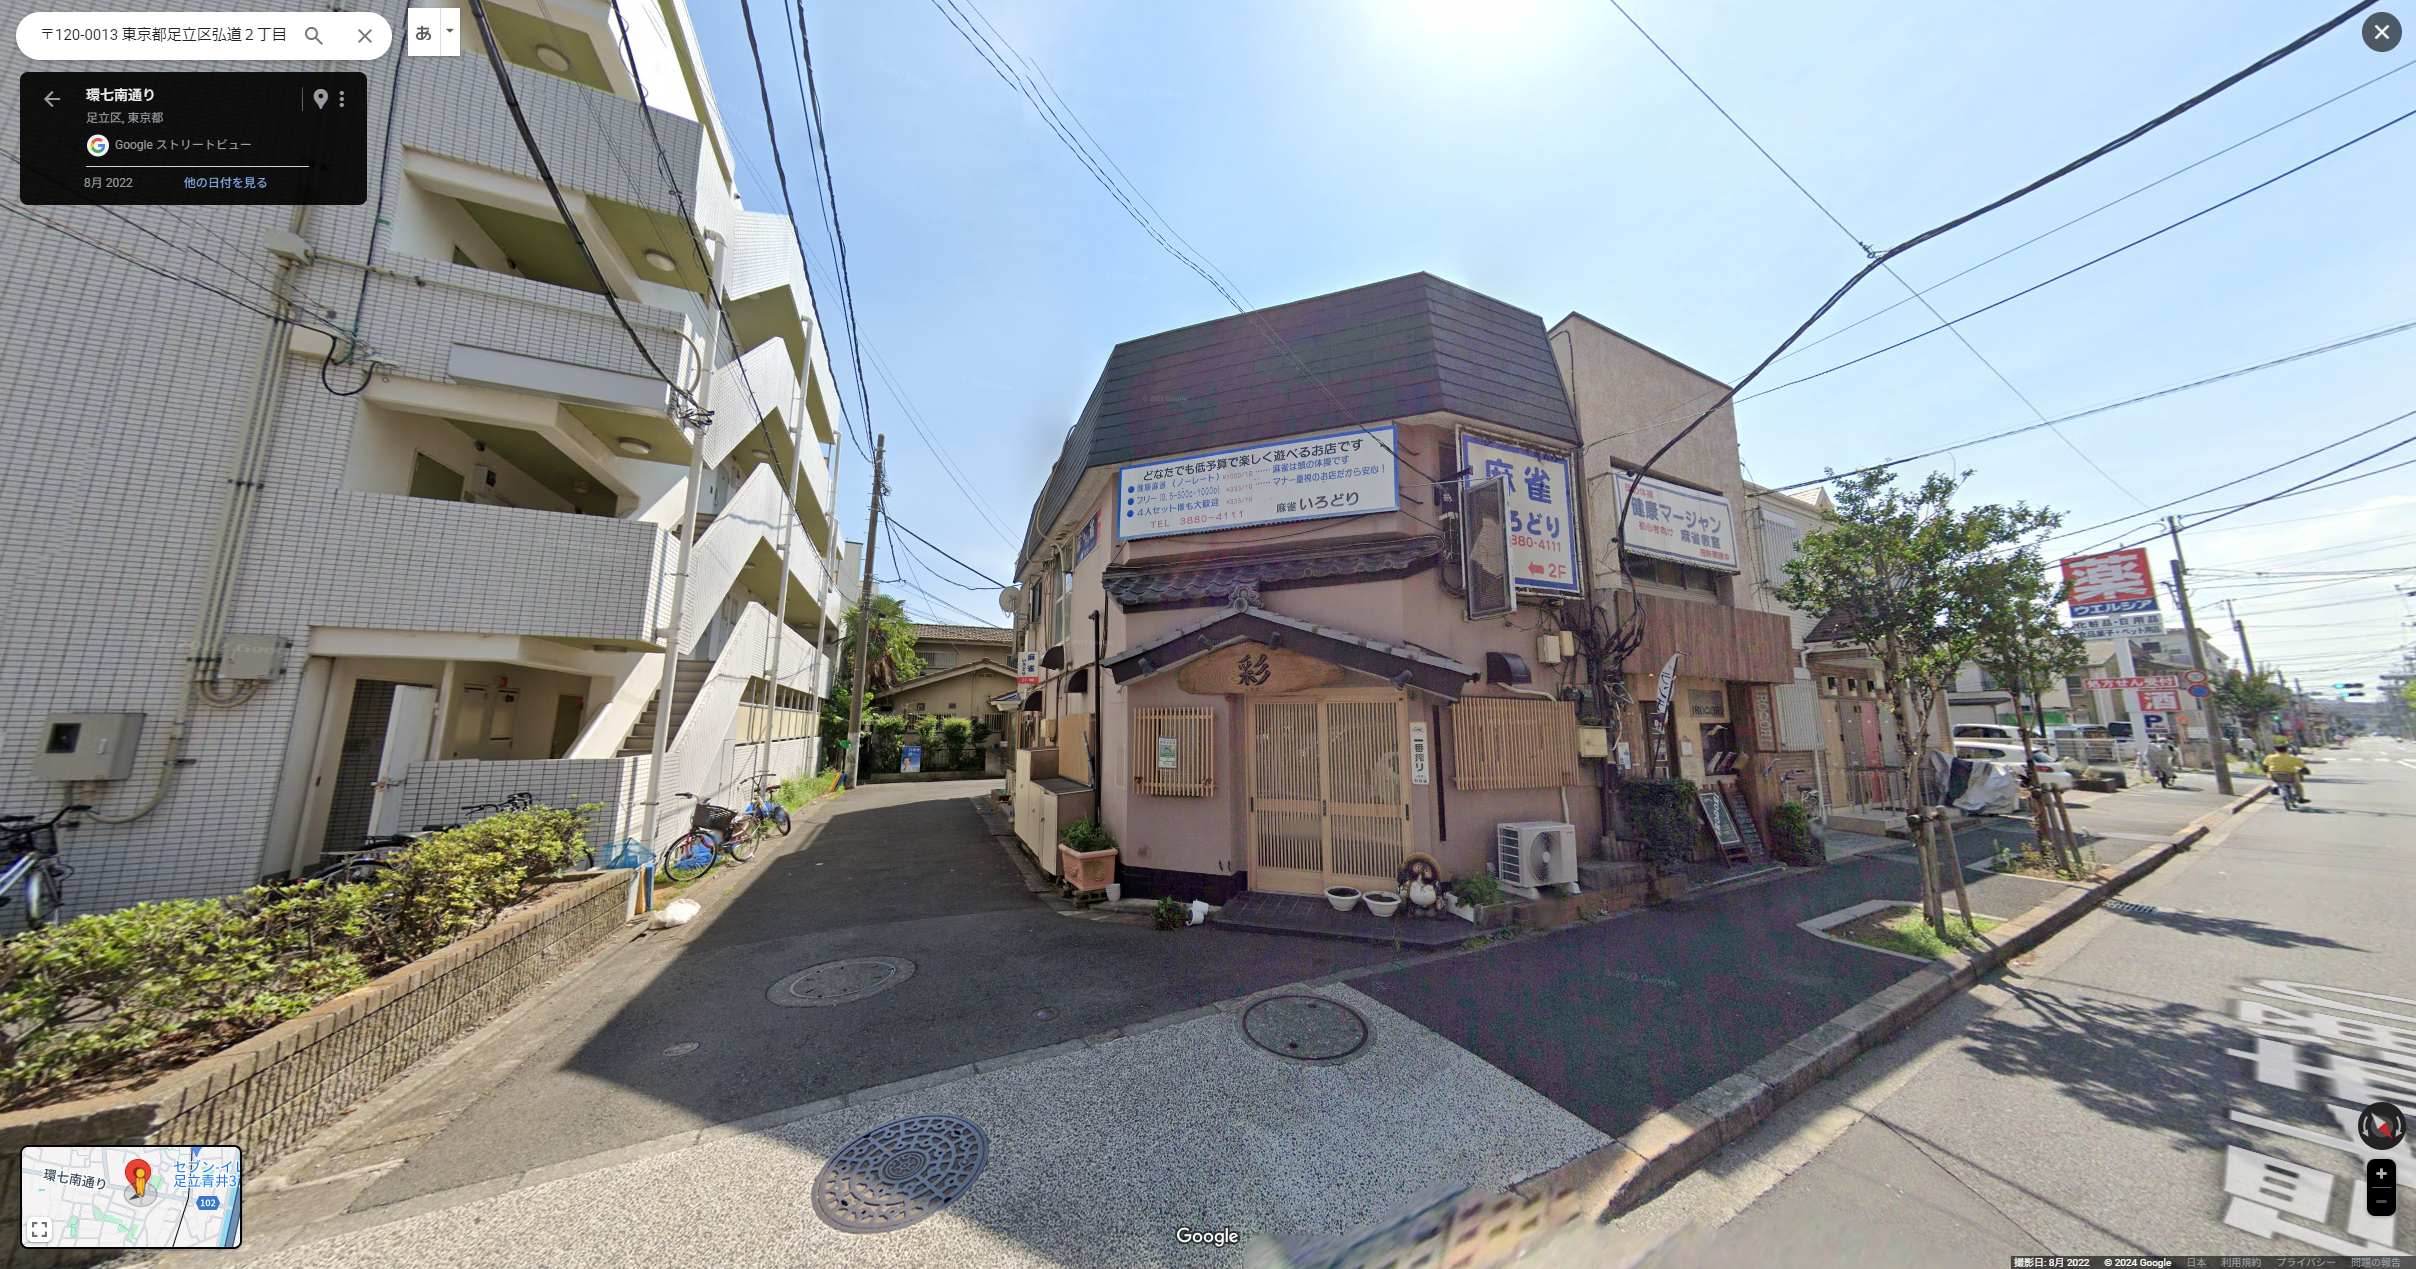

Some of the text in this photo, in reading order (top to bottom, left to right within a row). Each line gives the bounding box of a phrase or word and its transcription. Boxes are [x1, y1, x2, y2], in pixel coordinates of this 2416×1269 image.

[1143, 439, 1363, 481] どなたでも低予算で楽しく遊べるお店です
[1276, 491, 1359, 513] 麻雀 いろどり
[1150, 510, 1244, 529] TEL 3880-4111
[1631, 497, 1721, 534] 健康マージャン
[1680, 529, 1721, 549] 麻雀教室
[1548, 563, 1567, 579] 2F
[2069, 553, 2149, 602] 薬
[2073, 599, 2153, 616] ウエルシア
[1237, 654, 1271, 686] 彩
[2087, 677, 2173, 688] 処方せん受付
[2144, 691, 2178, 710] 酒
[2144, 715, 2163, 728] P
[1414, 739, 1425, 772] 一番搾り
